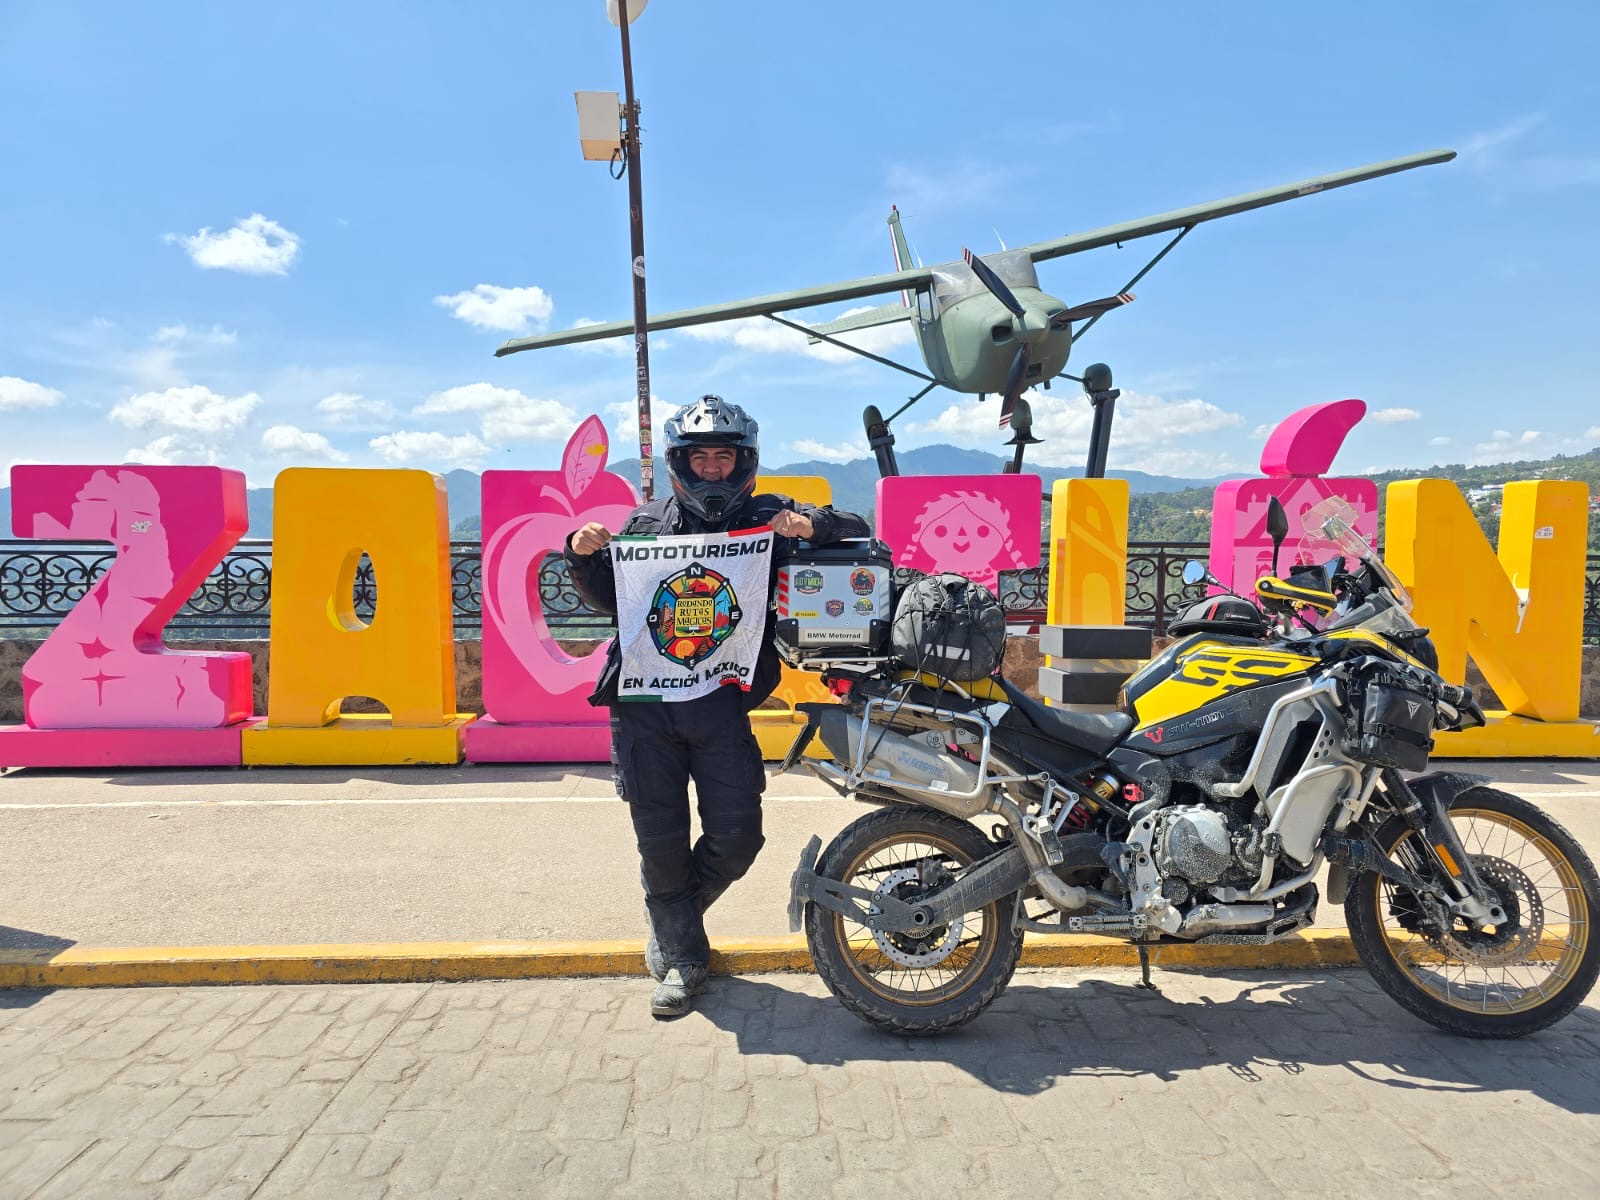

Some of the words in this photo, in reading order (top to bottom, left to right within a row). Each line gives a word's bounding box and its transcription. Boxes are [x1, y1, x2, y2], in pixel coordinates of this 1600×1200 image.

[616, 538, 770, 562] MOTOTURISMO
[690, 566, 701, 575] N
[731, 611, 740, 620] E
[829, 631, 861, 639] Motorrad
[623, 678, 643, 689] EN
[649, 673, 700, 689] ACCIÓN
